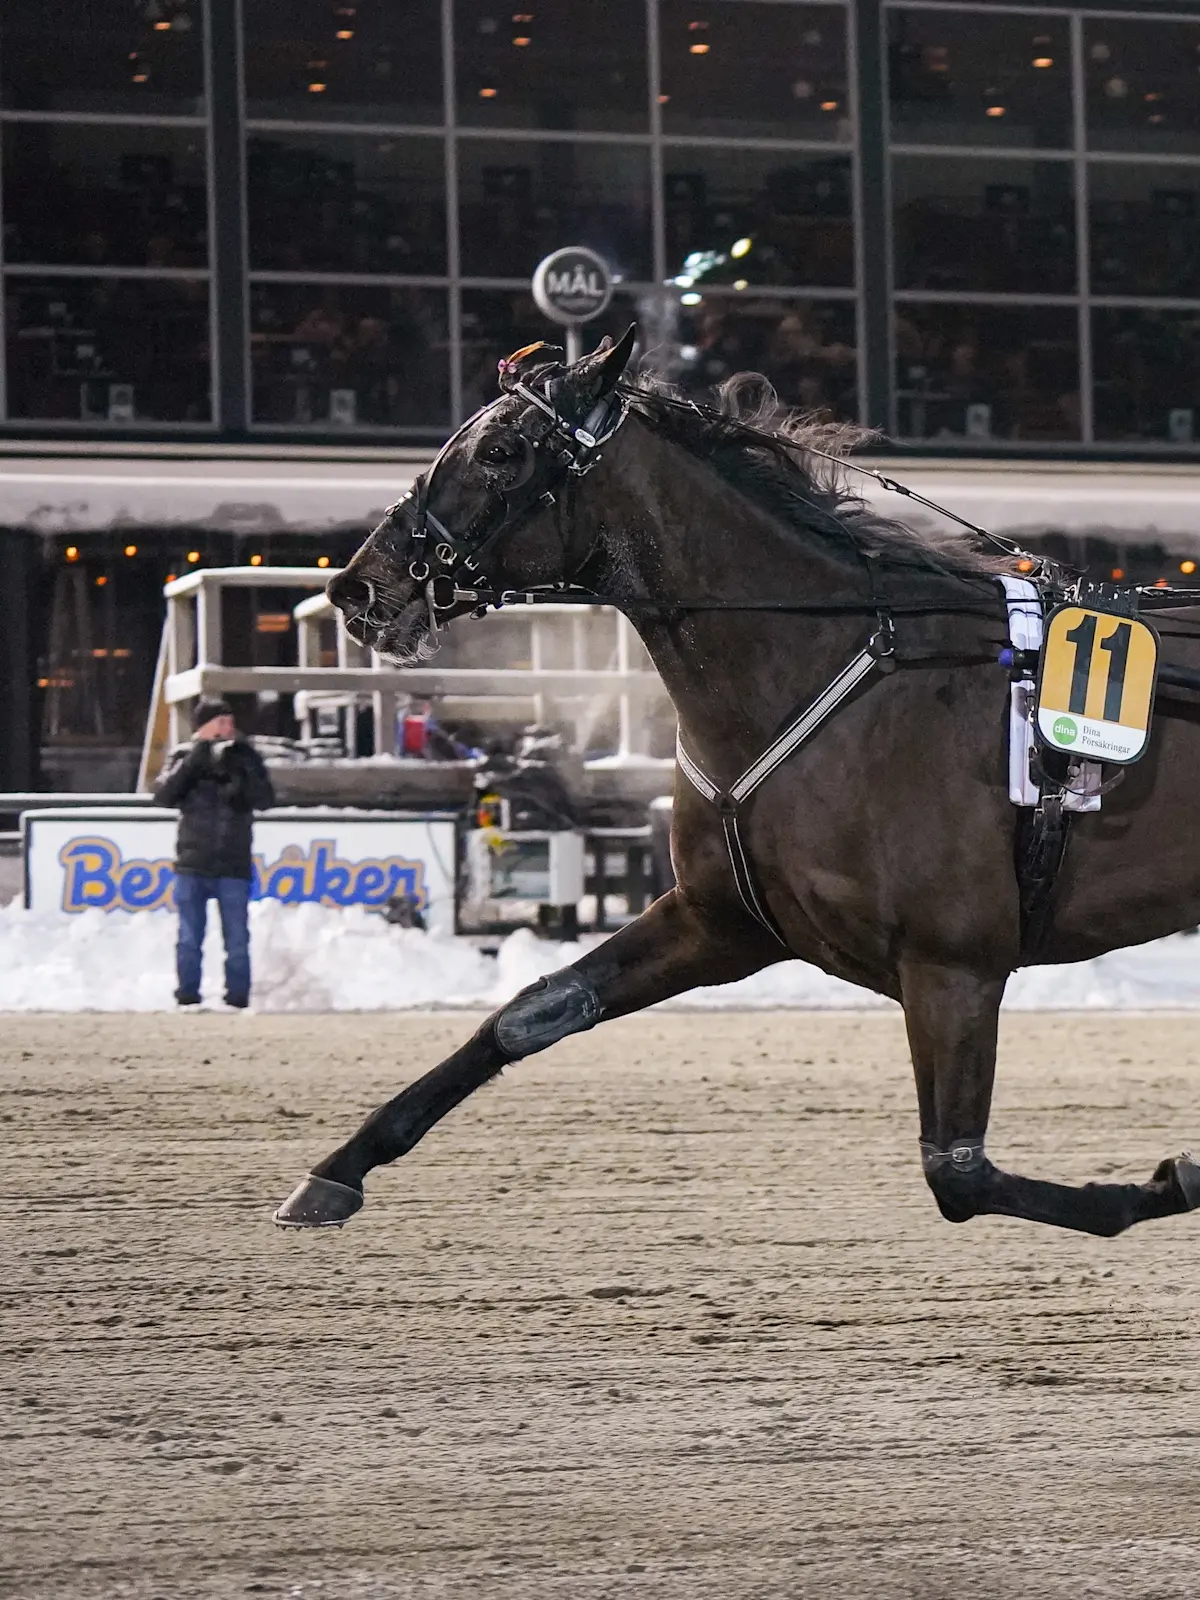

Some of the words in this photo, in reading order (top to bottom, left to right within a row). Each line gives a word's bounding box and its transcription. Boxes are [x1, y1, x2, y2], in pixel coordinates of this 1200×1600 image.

[547, 263, 606, 296] MÅL
[1065, 614, 1132, 723] 11
[1054, 723, 1076, 737] dina
[1082, 725, 1101, 738] Dina
[1081, 735, 1131, 755] Försäkringar
